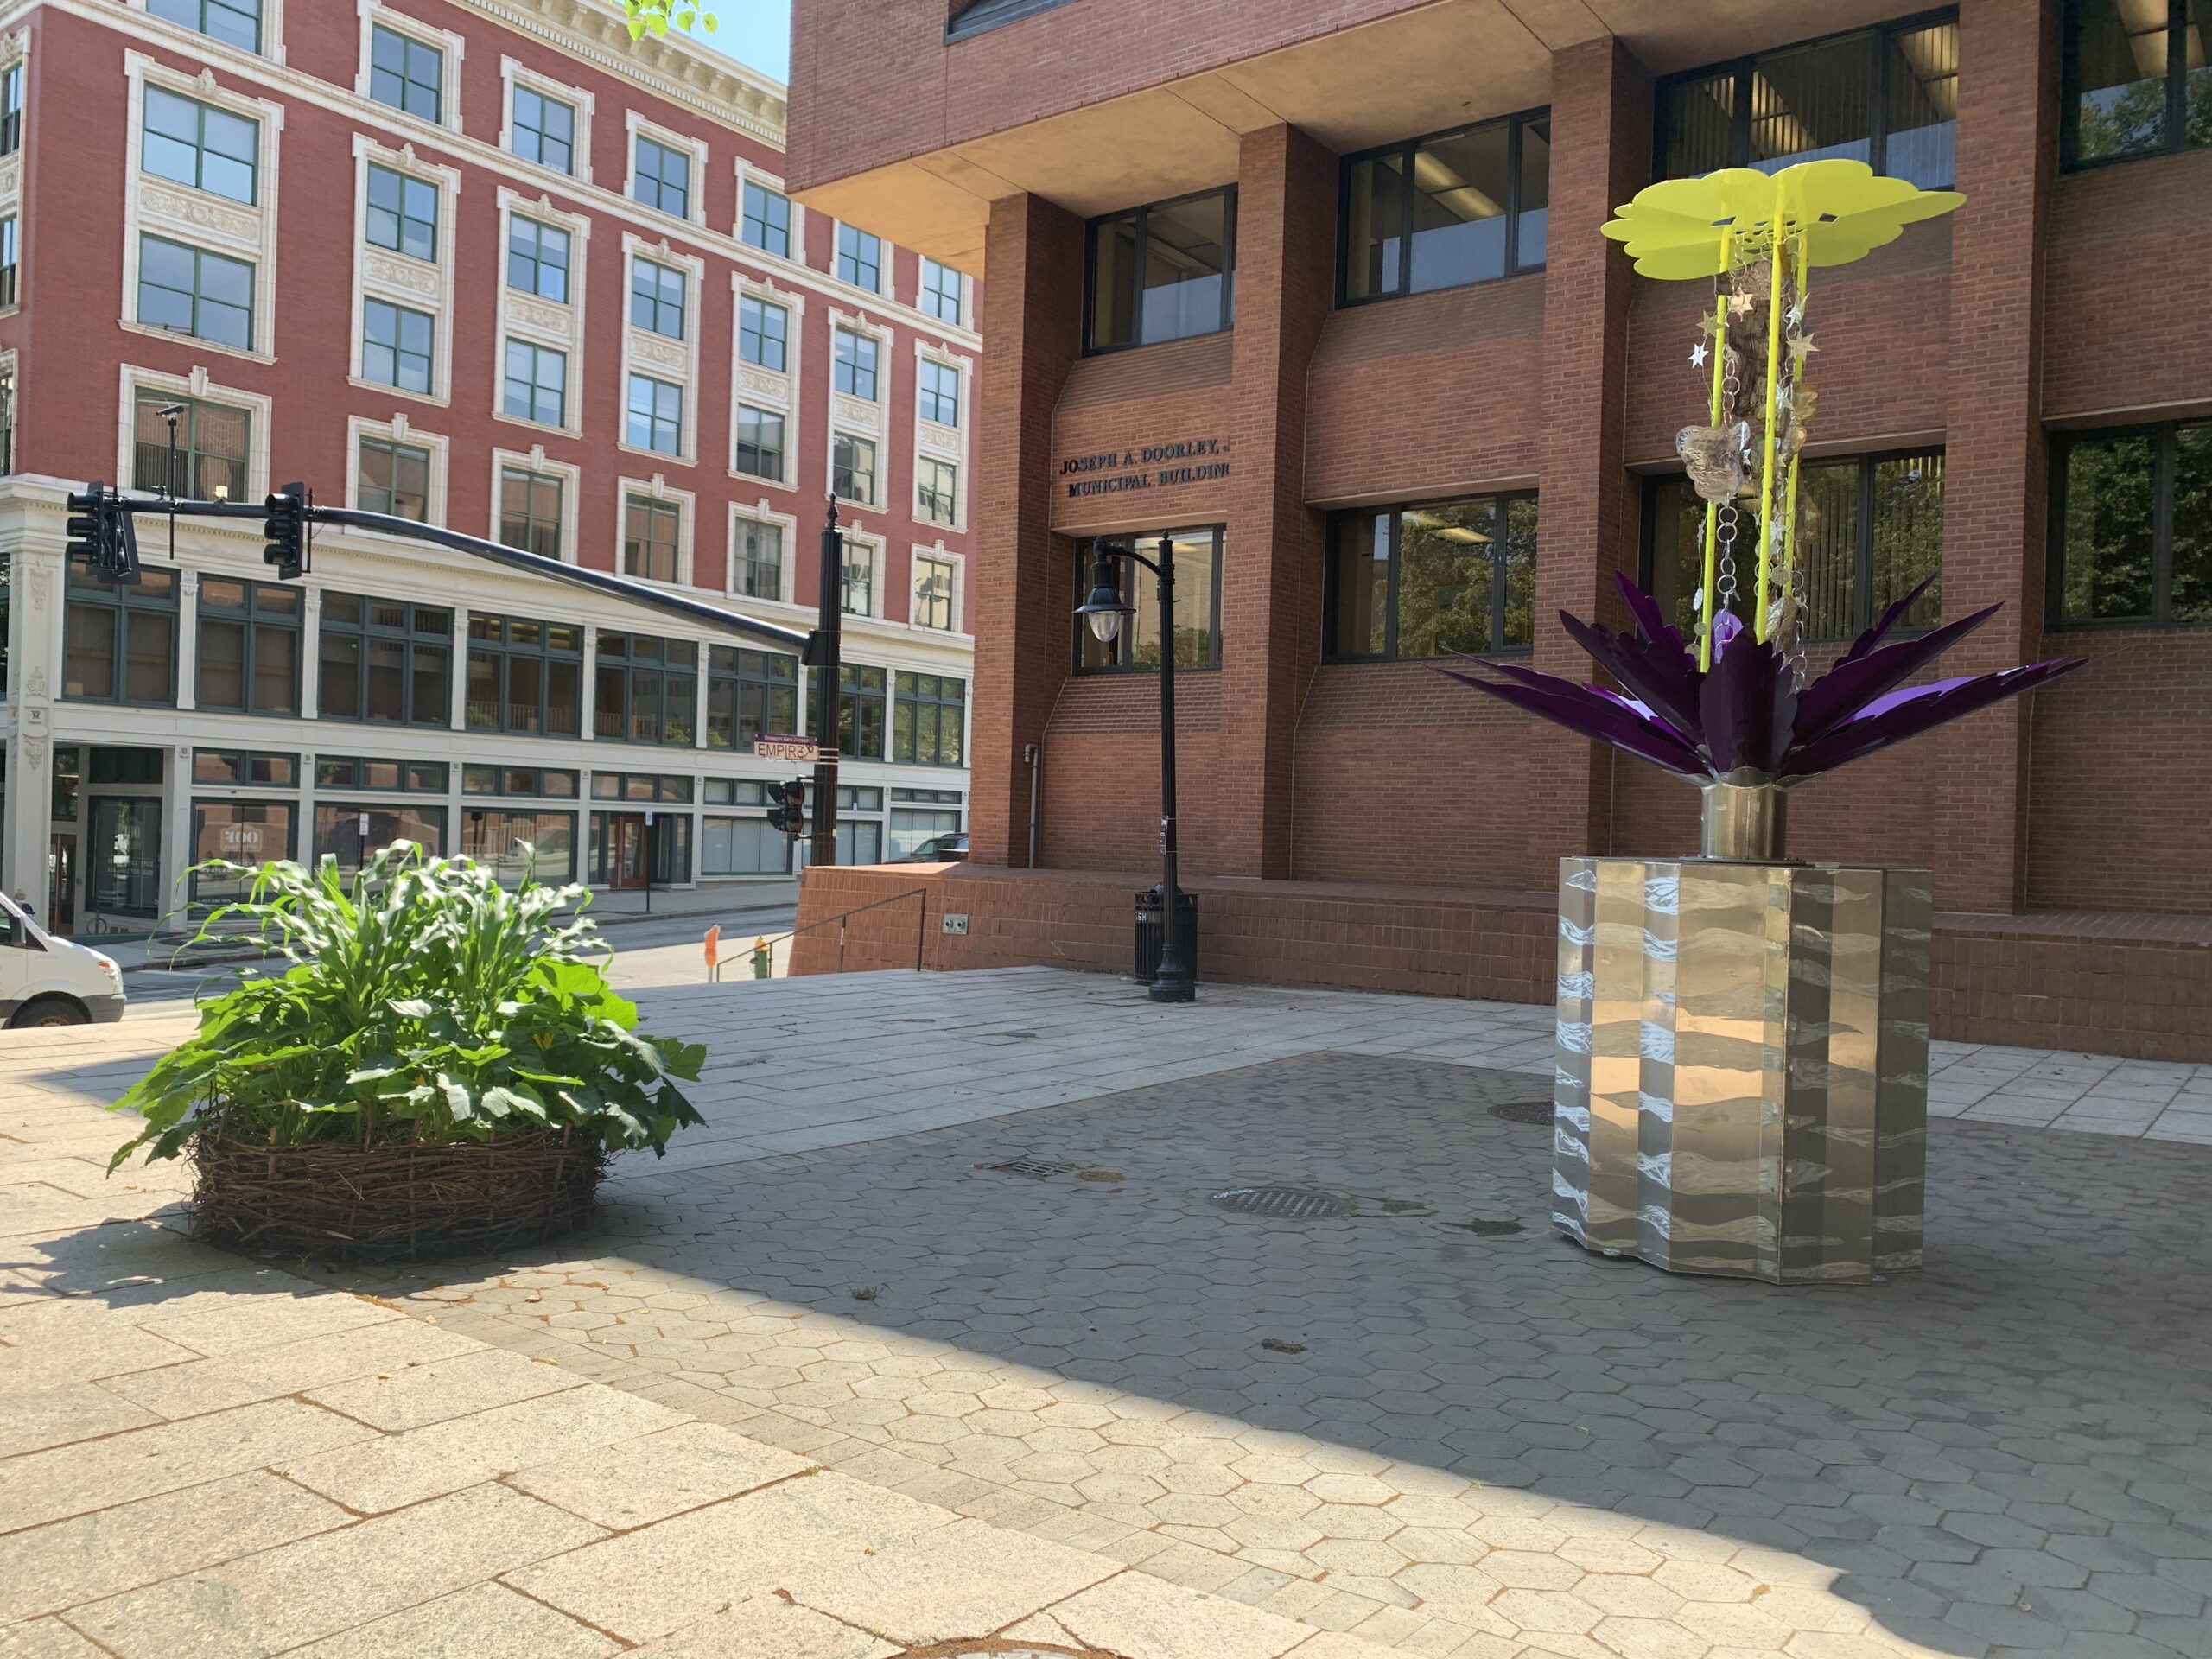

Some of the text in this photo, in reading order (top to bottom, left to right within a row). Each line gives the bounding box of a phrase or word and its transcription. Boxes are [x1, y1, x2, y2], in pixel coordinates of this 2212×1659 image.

[1059, 453, 1117, 475] JOSEPH
[1123, 453, 1138, 466] A.
[1141, 438, 1220, 463] DOORLEY,
[1068, 474, 1151, 498] MUNICIPAL
[758, 743, 804, 759] EMPIRE
